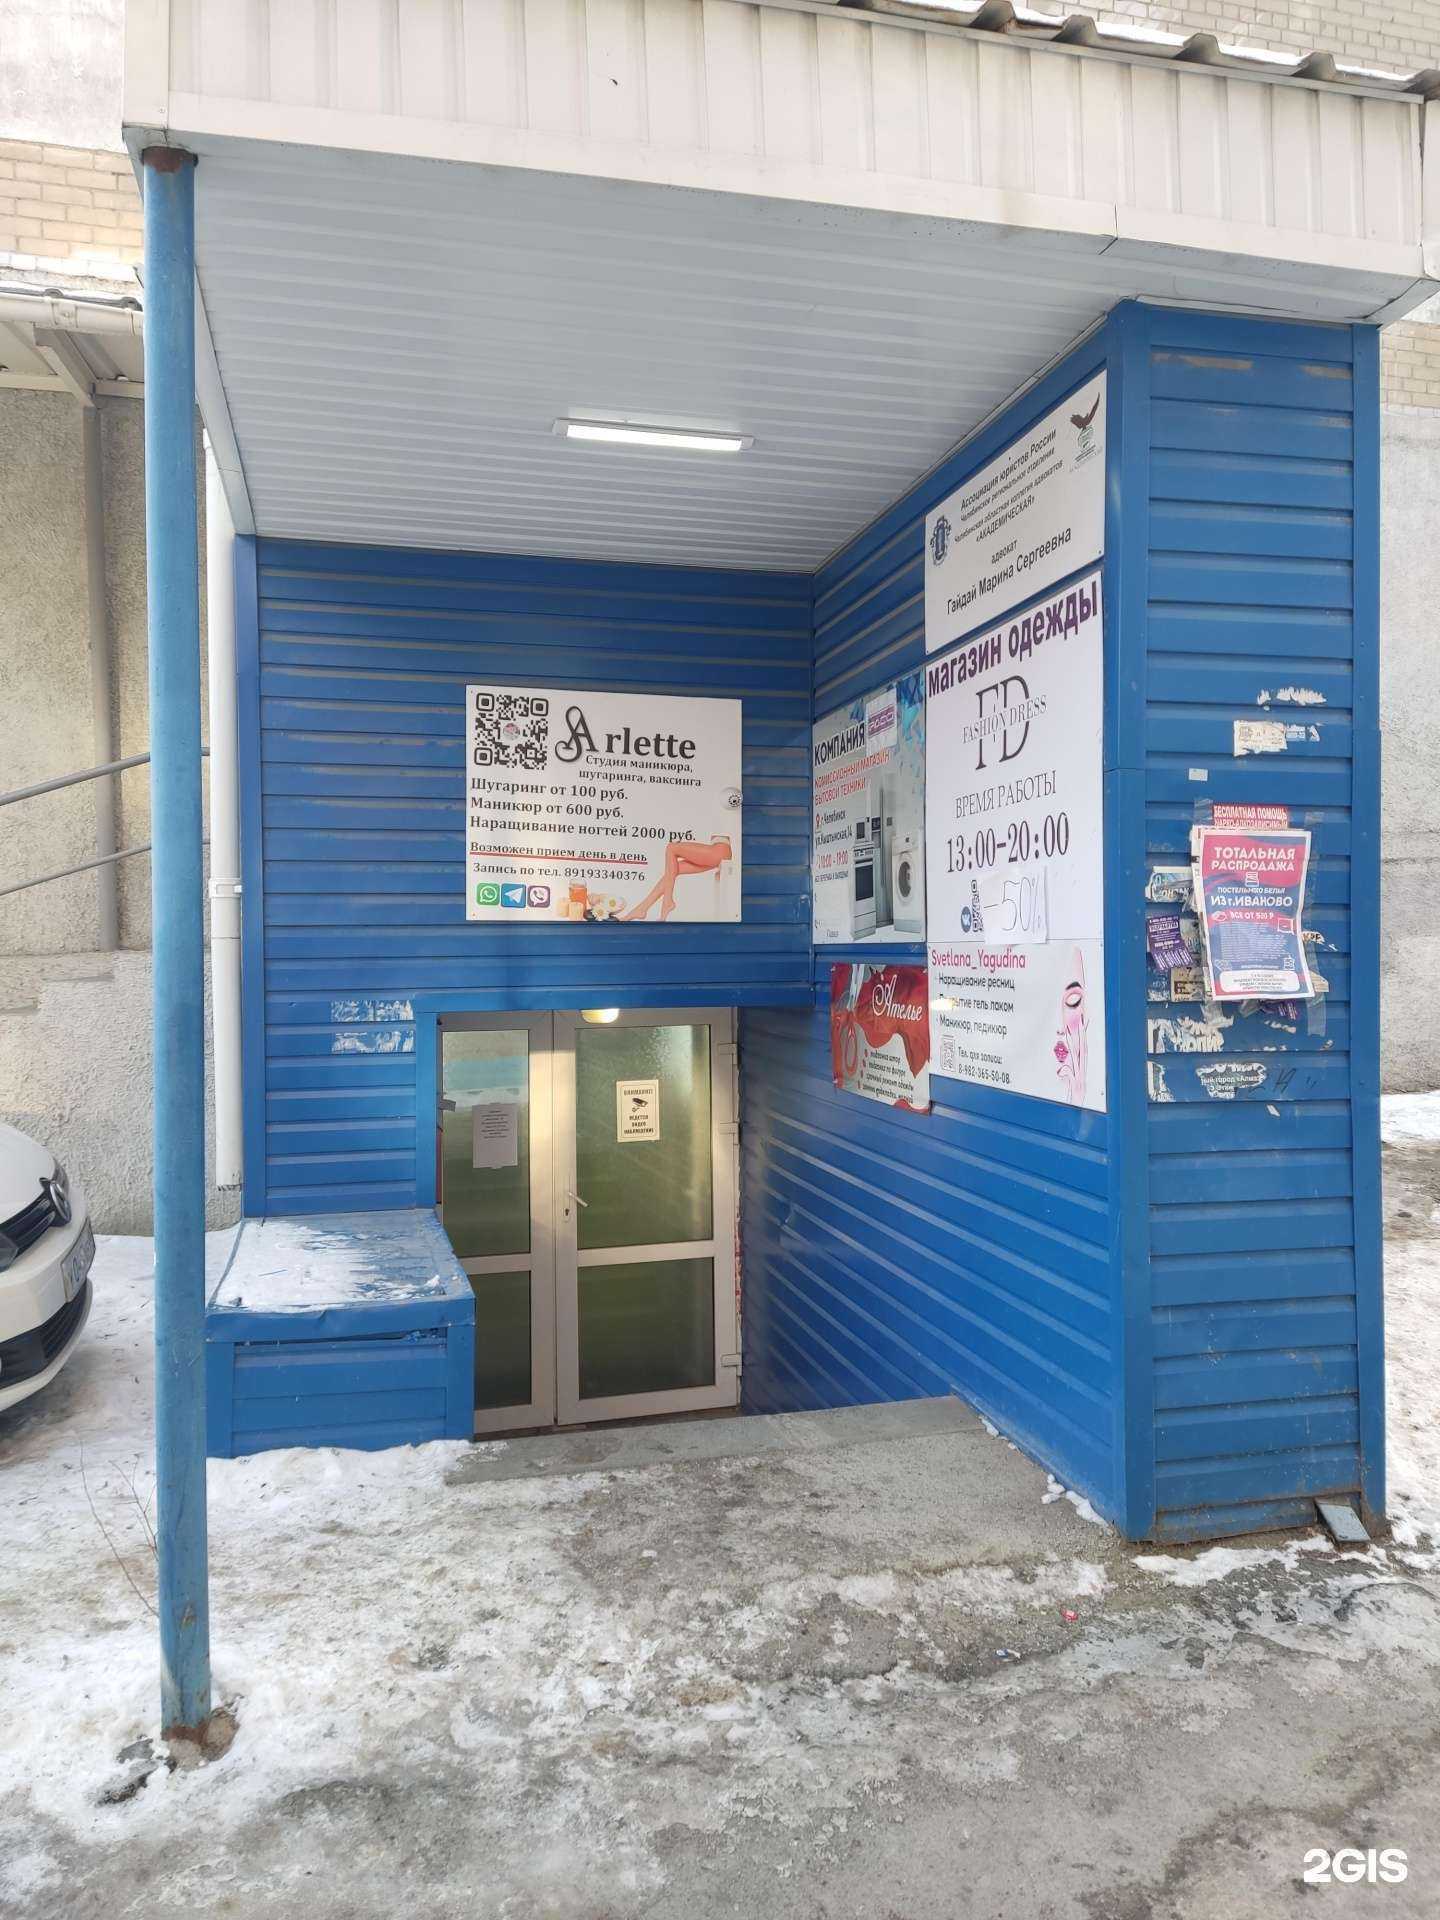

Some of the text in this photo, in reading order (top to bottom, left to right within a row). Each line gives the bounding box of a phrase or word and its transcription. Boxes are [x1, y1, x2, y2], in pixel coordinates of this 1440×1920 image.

[961, 429, 1056, 511] Ассоциация юристов России
[991, 539, 1018, 565] адвокат
[947, 527, 1072, 615] Гайдай Марина Сергеевна
[928, 581, 1098, 698] магазин одежды
[963, 695, 1047, 744] FASHION DRESS
[555, 706, 696, 762] Arlette
[815, 722, 865, 766] КОМПАНИЯ
[586, 755, 693, 773] Студия маникюра,
[471, 778, 628, 802] Шугаринг от 100 руб.
[579, 770, 702, 787] шугаринга, ваксинга
[955, 770, 1057, 819] ВРЕМЯ РАБОТЫ
[471, 797, 624, 820] Маникюр от 600 руб.
[1213, 805, 1287, 820] БЕСПЛАТНАЯ ПОМОЩЬ
[470, 816, 697, 843] Наращивание ногтей 2000 руб.
[470, 842, 533, 855] Возможен
[537, 846, 576, 858] прием
[578, 850, 607, 860] день
[619, 851, 647, 863] день
[947, 812, 1069, 873] 13:00-20:00
[1214, 847, 1296, 860] ТОТАЛЬНАЯ
[473, 863, 646, 881] Запись по тел. 89193340376
[1211, 860, 1295, 871] РАСПРОДАЖА
[1211, 896, 1226, 906] ИЗ
[1244, 911, 1254, 920] ОТ
[931, 948, 1026, 974] Svetlana_Yagudina
[939, 972, 1015, 991] Наращивание ресниц
[872, 974, 922, 1021] Ателье
[973, 999, 989, 1010] гель
[990, 1001, 1014, 1012] лаком
[939, 1014, 1008, 1039] Маникюр, педикюр
